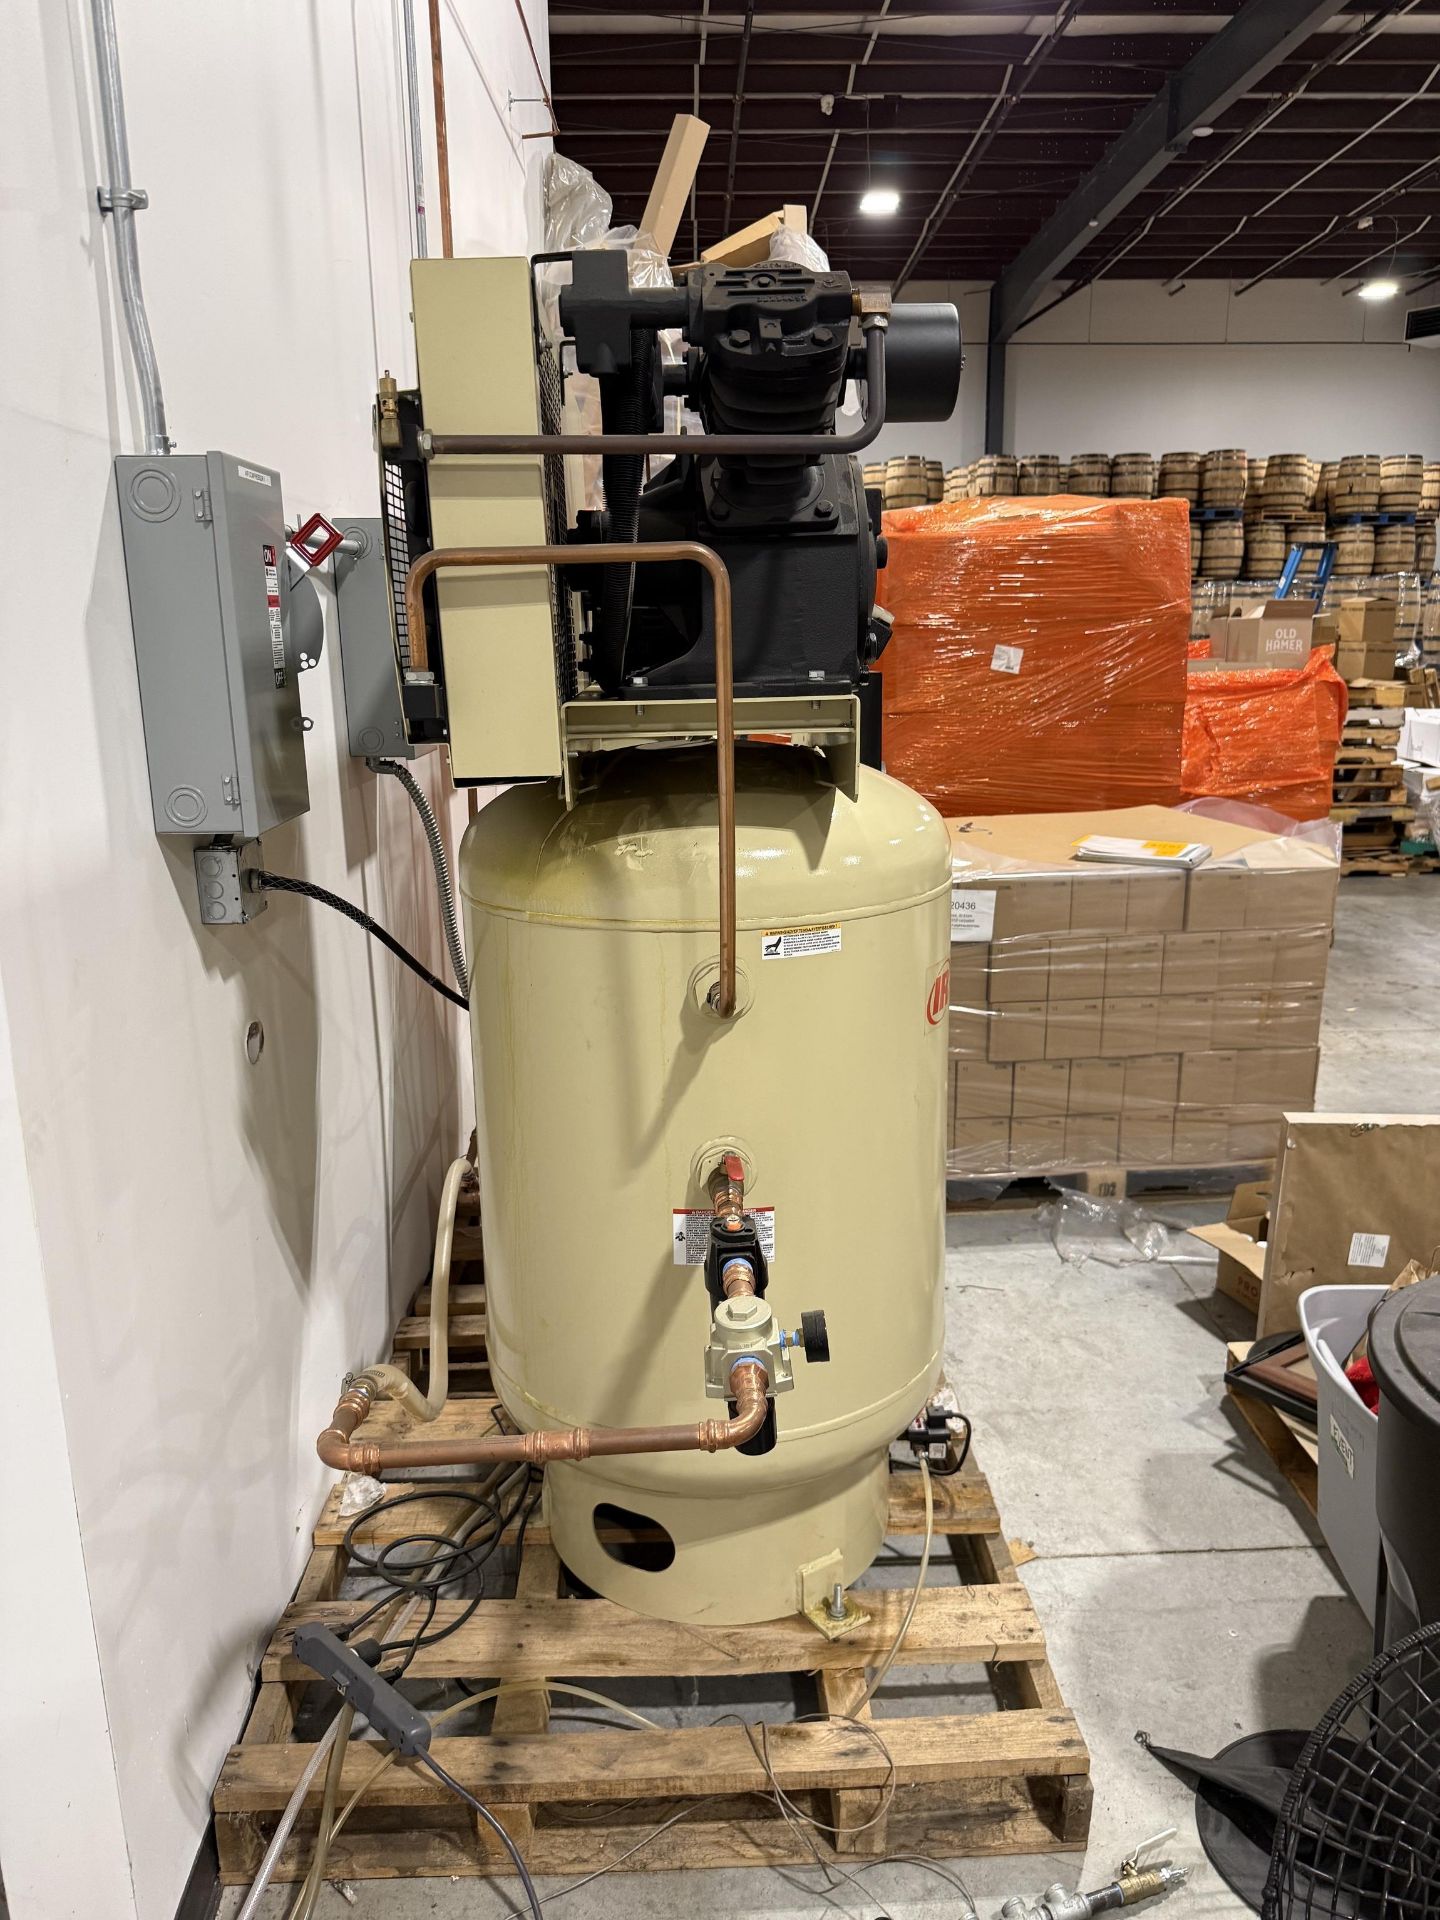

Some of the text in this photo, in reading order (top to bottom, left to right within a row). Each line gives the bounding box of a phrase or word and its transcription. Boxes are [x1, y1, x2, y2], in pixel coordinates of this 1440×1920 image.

[264, 548, 272, 563] ON
[1275, 628, 1297, 639] OLD
[1265, 639, 1303, 652] HAMER
[275, 671, 284, 685] OFF
